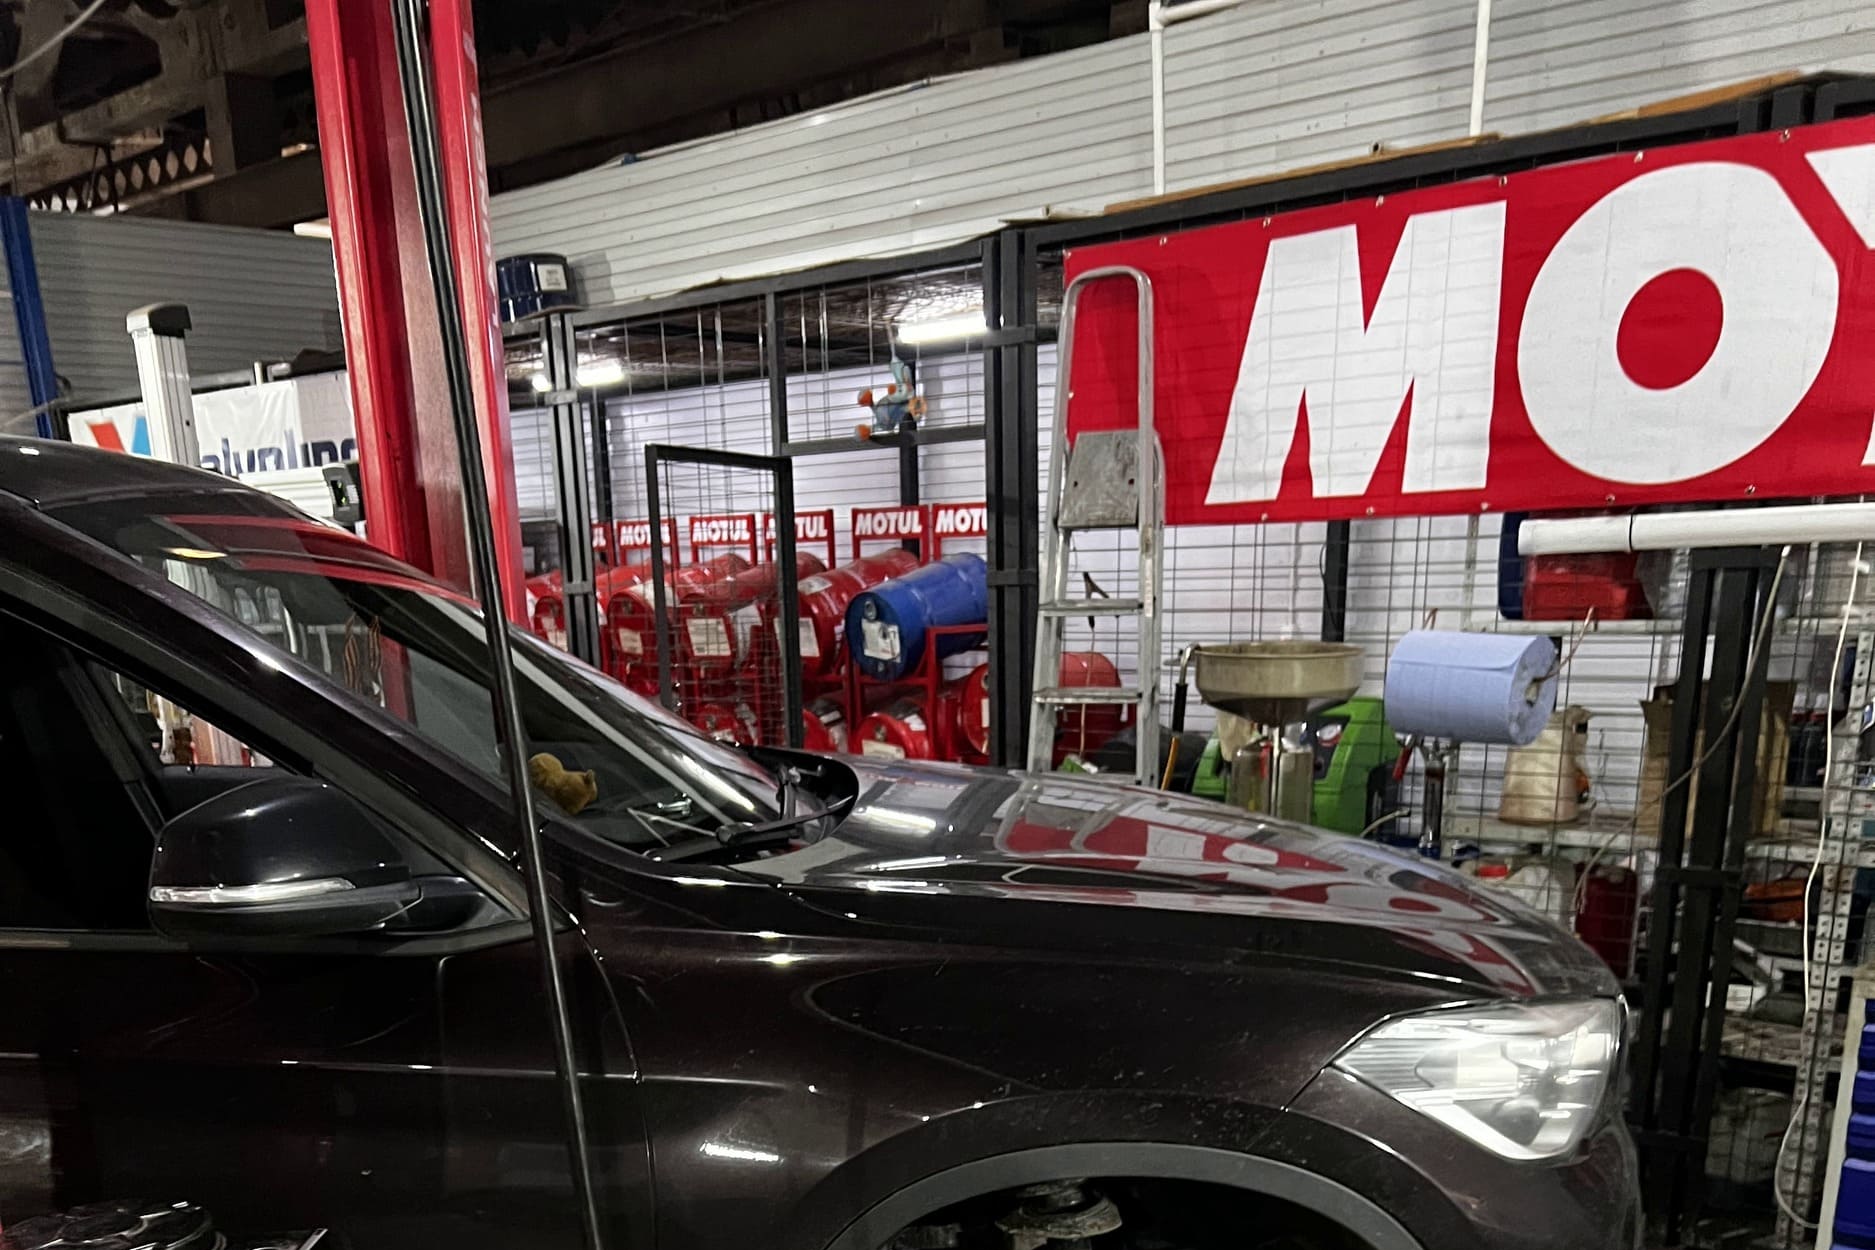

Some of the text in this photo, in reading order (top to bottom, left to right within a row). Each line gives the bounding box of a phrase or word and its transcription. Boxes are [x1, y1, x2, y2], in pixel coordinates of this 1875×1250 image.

[692, 519, 750, 542] MOTUL
[766, 515, 828, 539] MTUL
[855, 509, 922, 535] MOTUL
[936, 507, 987, 533] MOT
